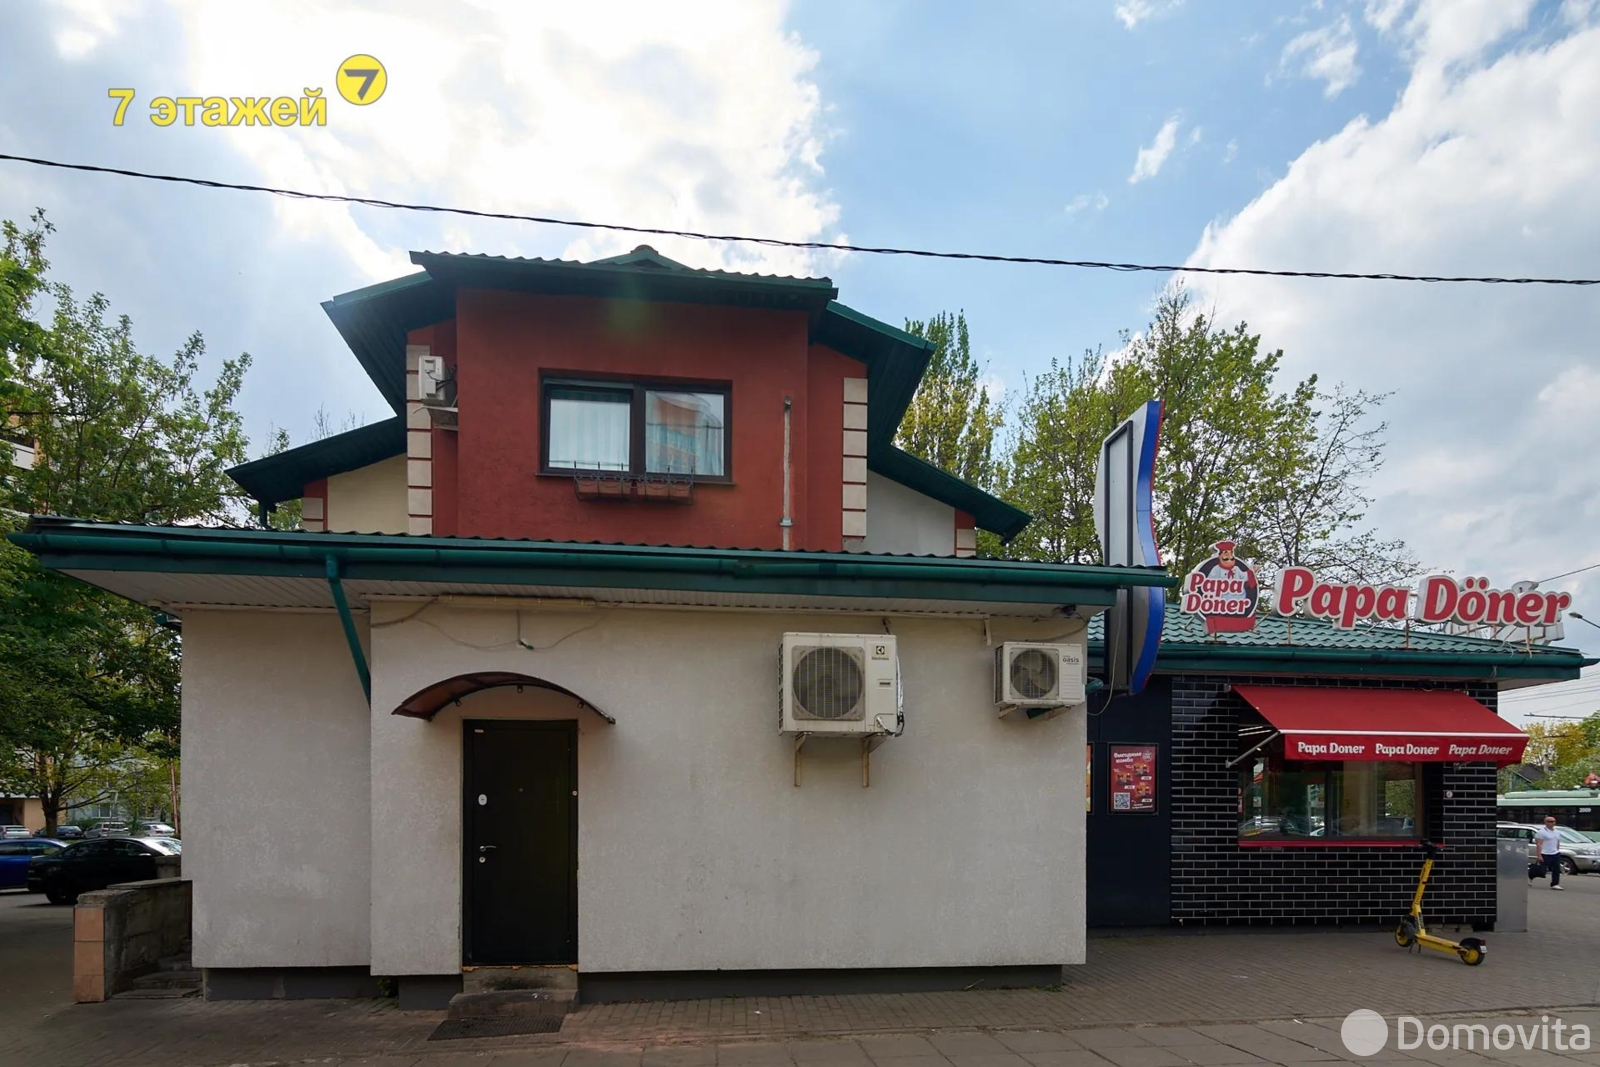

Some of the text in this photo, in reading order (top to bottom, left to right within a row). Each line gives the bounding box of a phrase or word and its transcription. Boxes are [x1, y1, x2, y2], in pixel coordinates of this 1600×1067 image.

[1189, 573, 1243, 597] Papa
[1186, 594, 1251, 614] Döner
[1278, 567, 1571, 628] Papa Döner
[1297, 741, 1365, 755] Papa Doner
[1375, 743, 1439, 757] Papa Doner
[1448, 744, 1513, 756] Papa Doner
